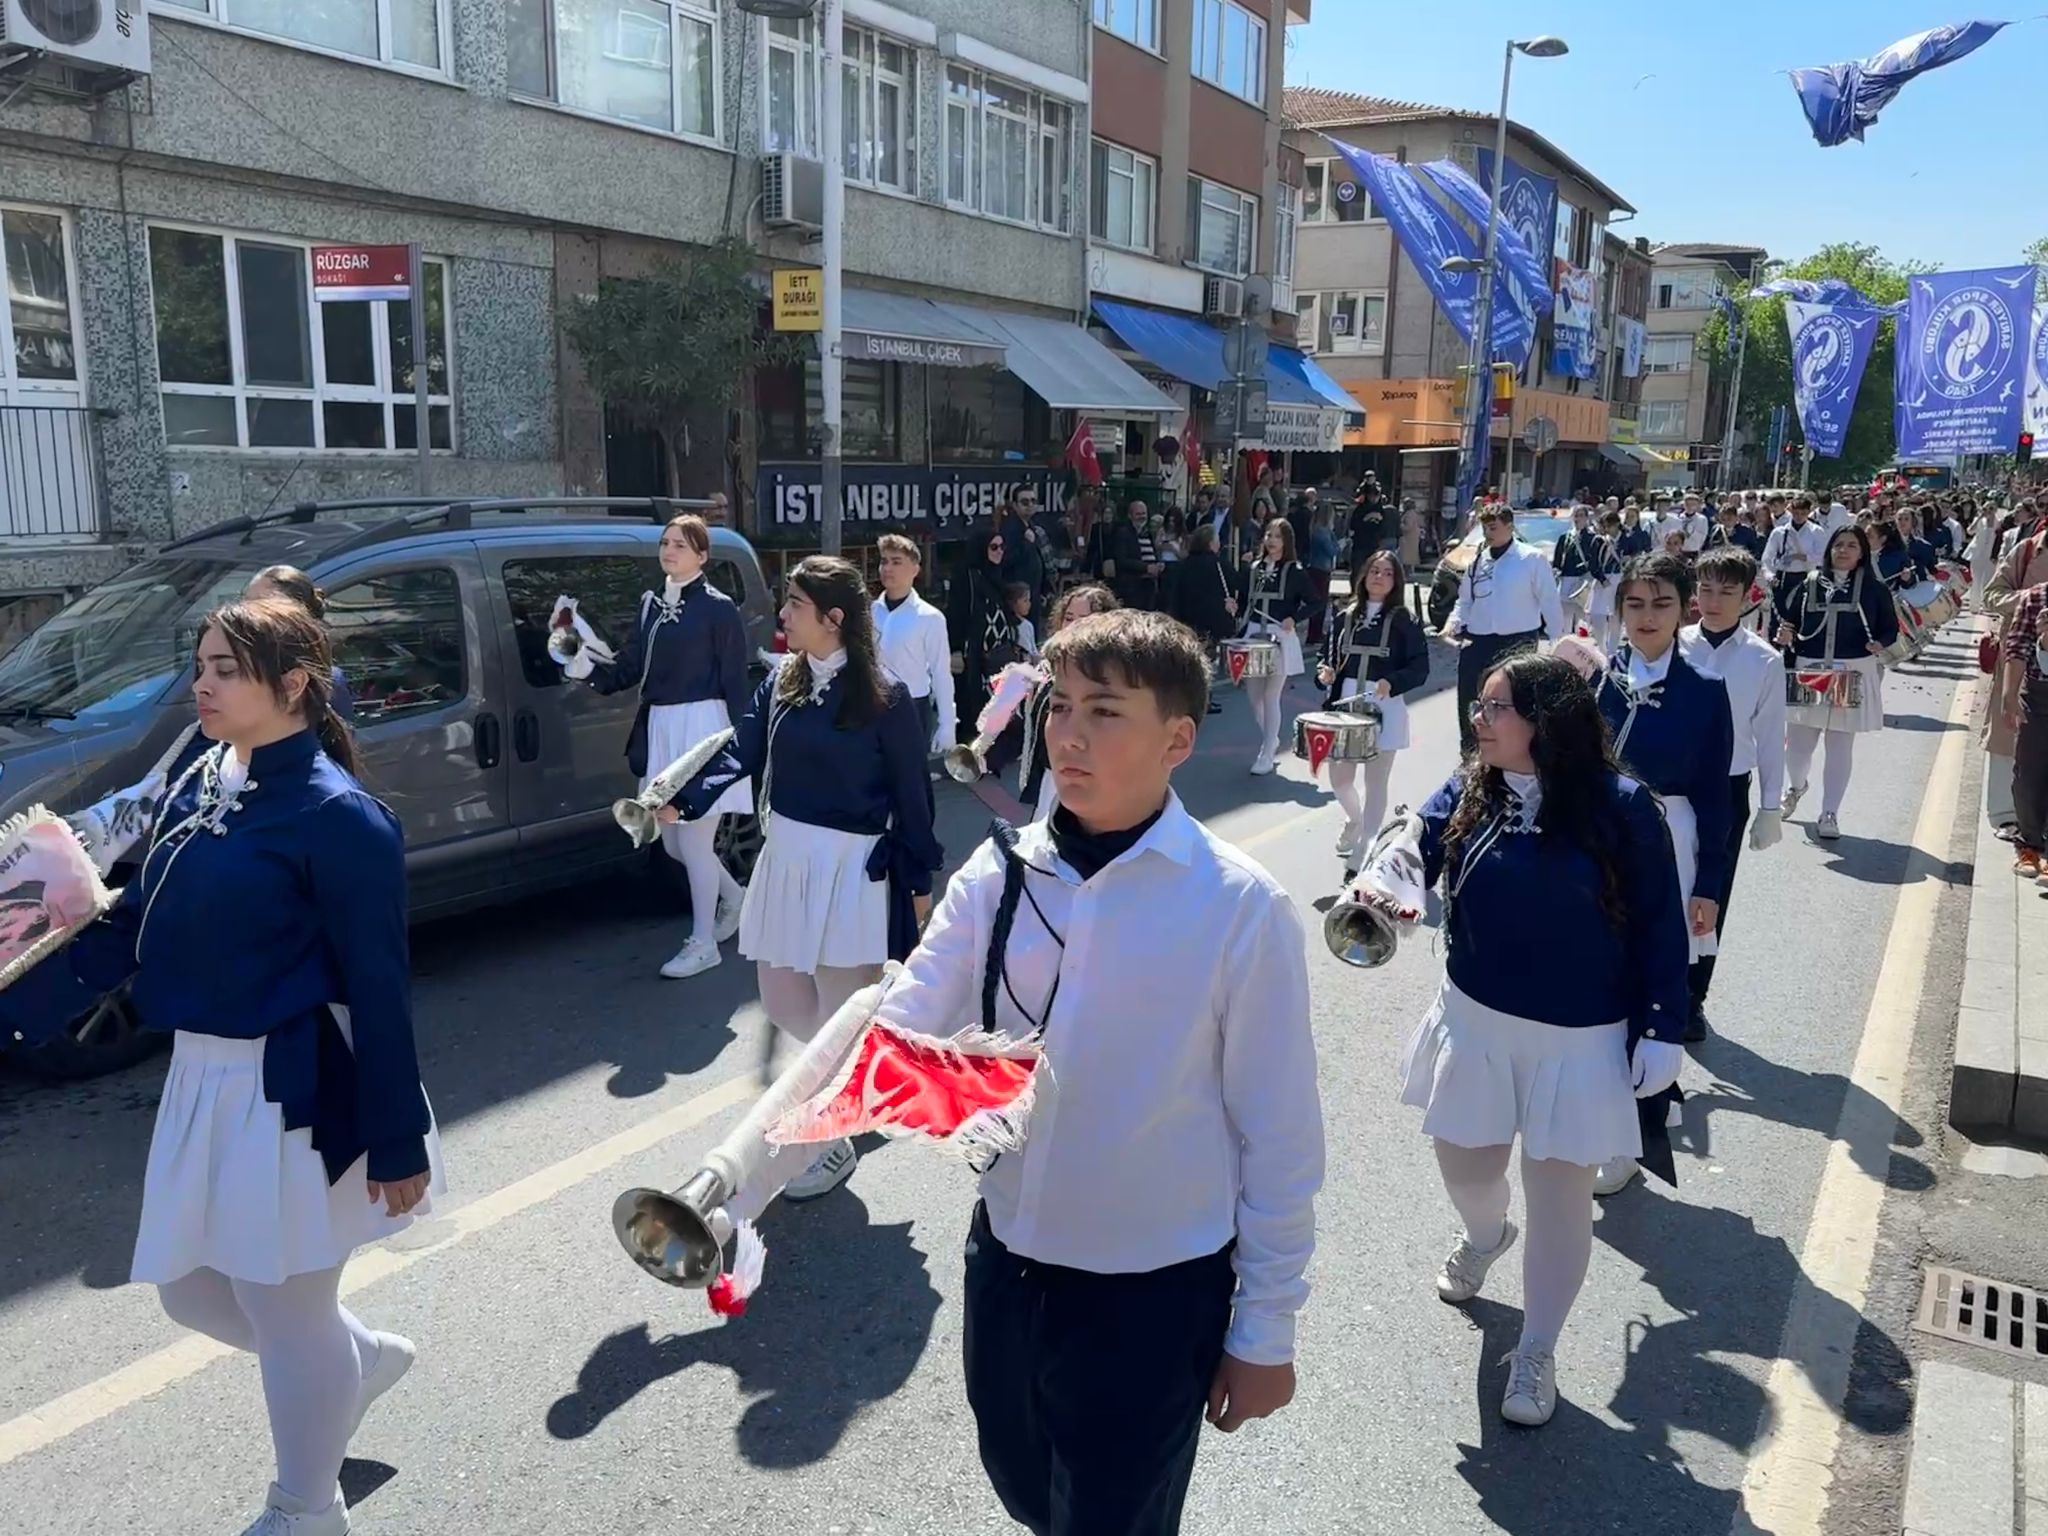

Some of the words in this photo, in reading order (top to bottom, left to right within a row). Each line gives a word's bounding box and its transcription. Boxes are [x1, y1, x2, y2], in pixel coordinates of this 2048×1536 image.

[316, 252, 369, 270] RÜZGAR
[789, 273, 808, 288] İETT
[783, 289, 816, 304] DURAĞI
[867, 335, 925, 358] İSTANBUL
[776, 474, 926, 523] İSTNBUL
[935, 473, 1067, 526] ÇİÇEKLİK
